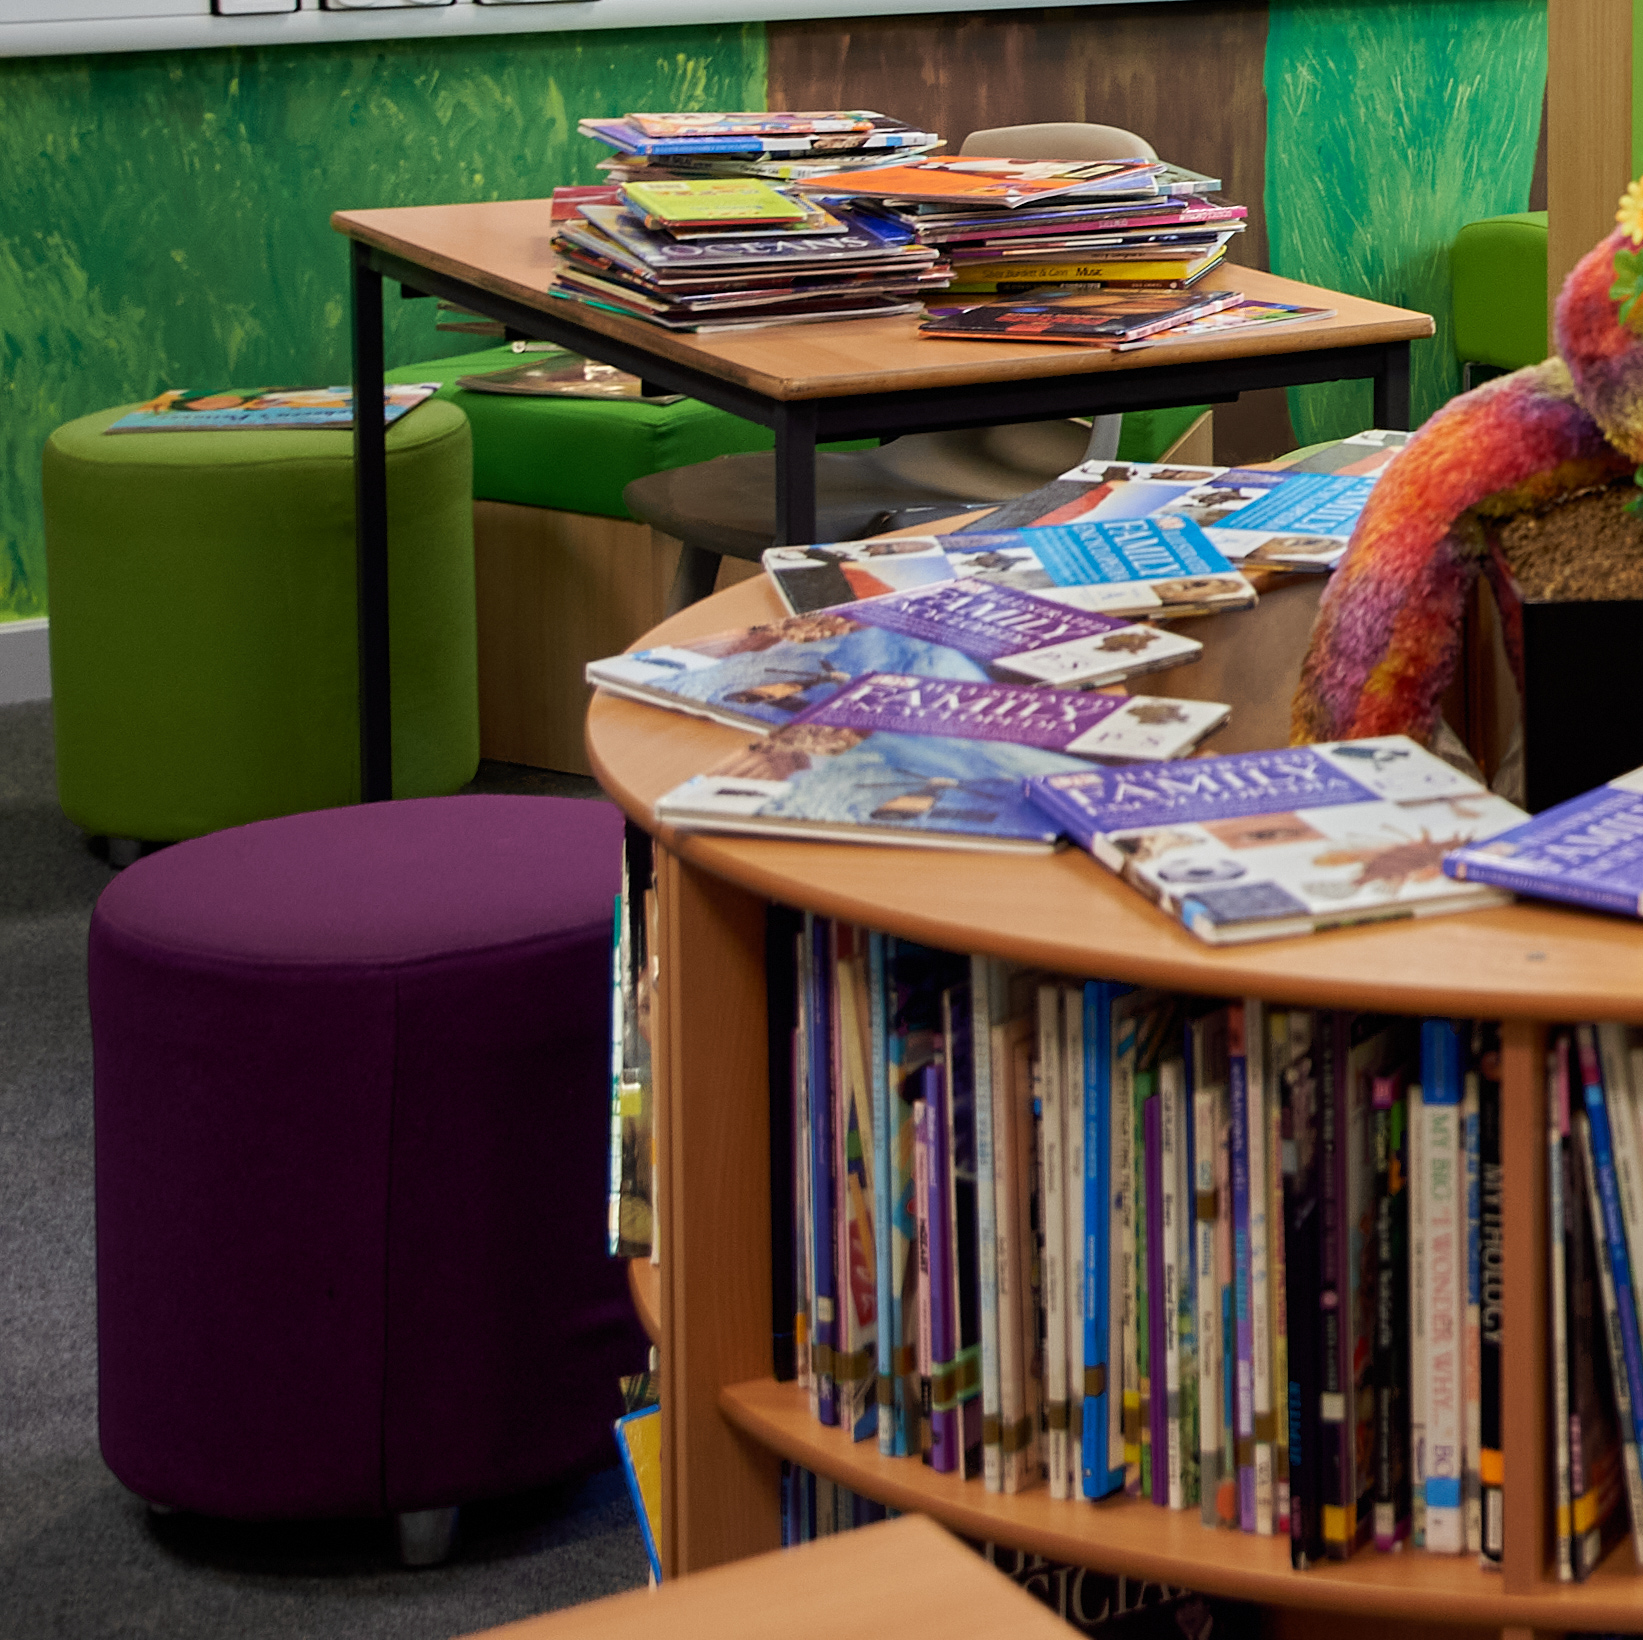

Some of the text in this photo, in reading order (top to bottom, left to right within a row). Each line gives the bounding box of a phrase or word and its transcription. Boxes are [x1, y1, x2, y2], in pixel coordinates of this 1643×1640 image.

[661, 235, 869, 258] OCEANS
[1075, 266, 1103, 277] Music
[1103, 518, 1186, 577] FAMILY
[934, 591, 1070, 641] FAMILY
[851, 684, 1078, 722] FAMILY
[1068, 760, 1317, 815] FAMILY
[1430, 1112, 1451, 1149] MY
[1430, 1157, 1452, 1201] BIG
[1480, 1161, 1504, 1346] MYTHOLOGY
[1430, 1231, 1454, 1345] WONDER
